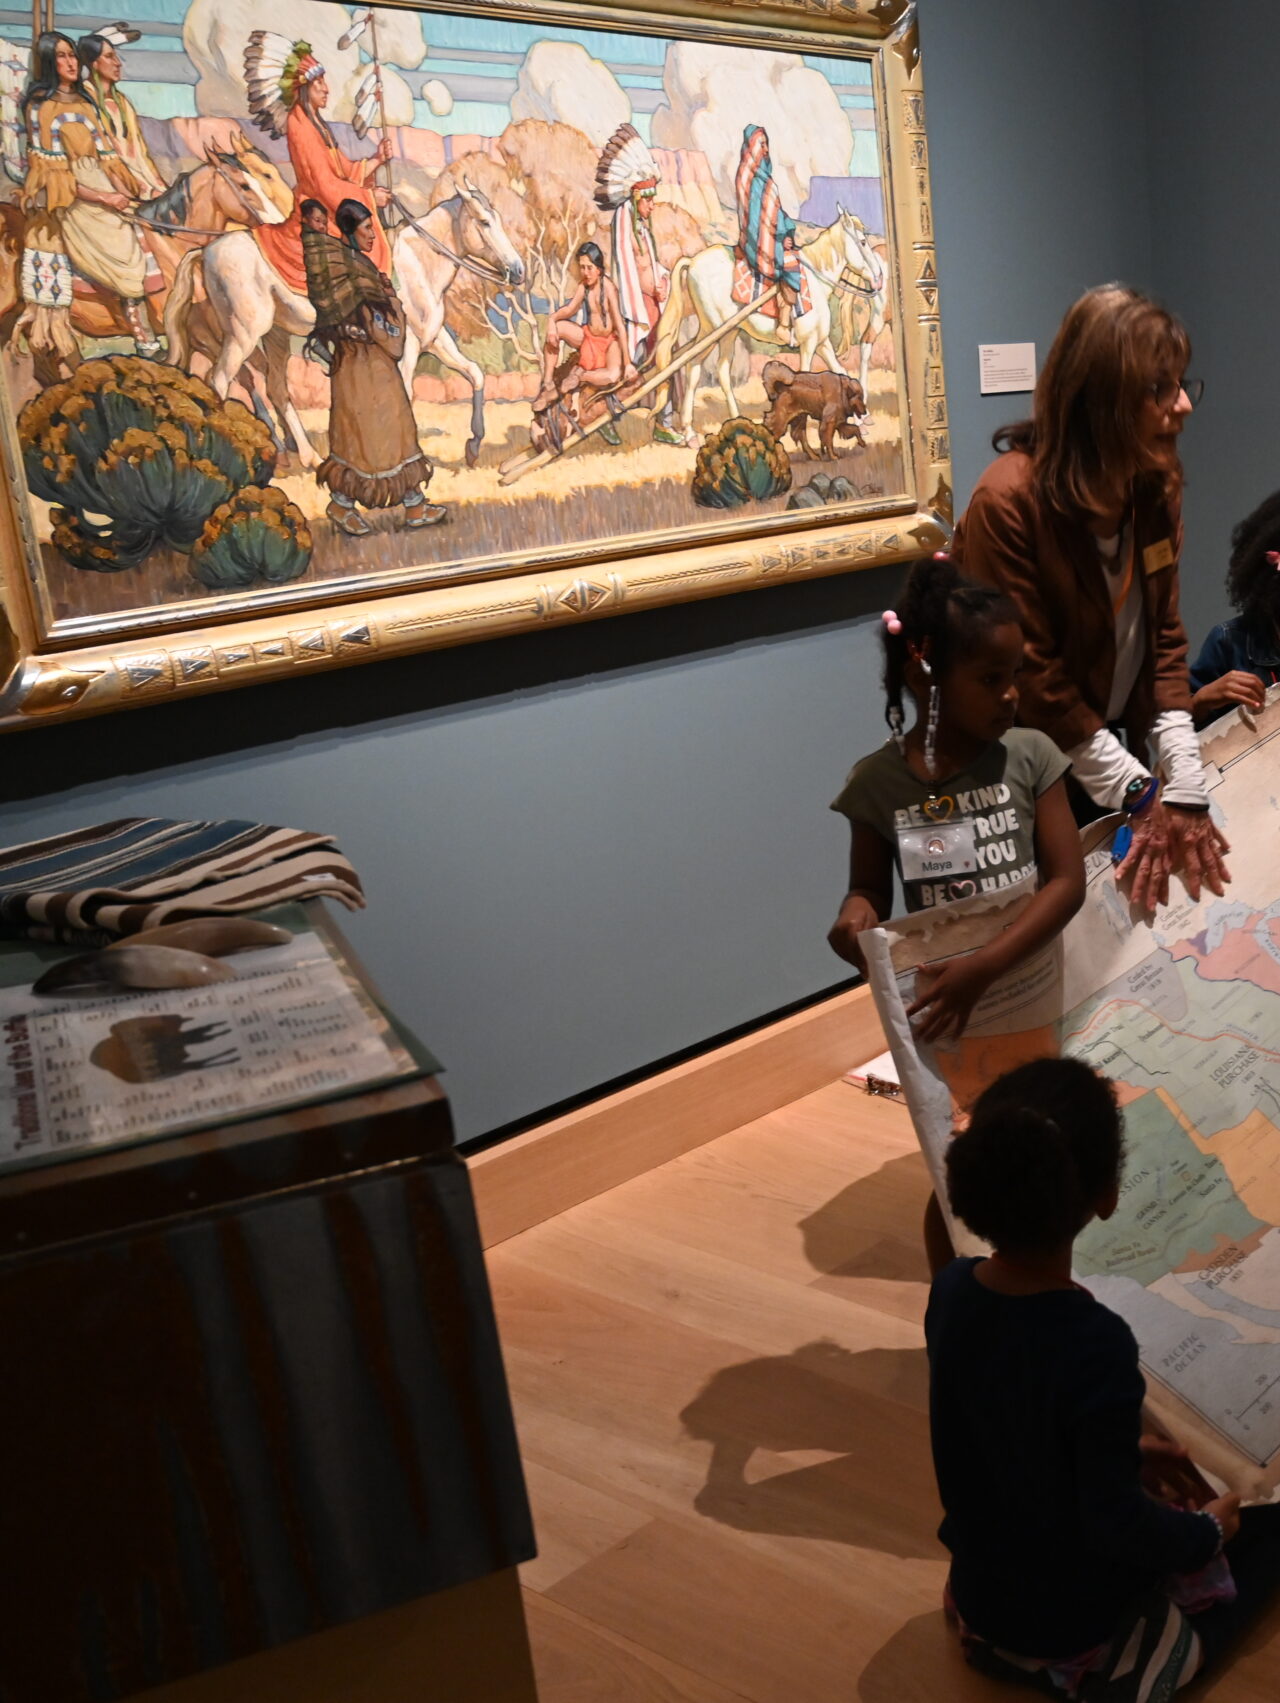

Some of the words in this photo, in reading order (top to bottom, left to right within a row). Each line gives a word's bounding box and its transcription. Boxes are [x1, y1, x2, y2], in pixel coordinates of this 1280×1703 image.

[894, 804, 923, 829] BE
[956, 783, 1011, 815] KIND
[921, 860, 953, 872] Maya
[975, 839, 1017, 870] YOU
[920, 883, 947, 906] BE
[1209, 1044, 1251, 1081] LOUISIANA
[1218, 1051, 1261, 1089] PURCHASE
[1118, 1167, 1152, 1199] SSION
[1200, 1183, 1216, 1198] Santa
[1198, 1248, 1239, 1281] GADSDEN
[1206, 1253, 1249, 1290] PURCHASE
[1162, 1331, 1200, 1368] PACIFIC
[1174, 1341, 1208, 1374] OCEAN
